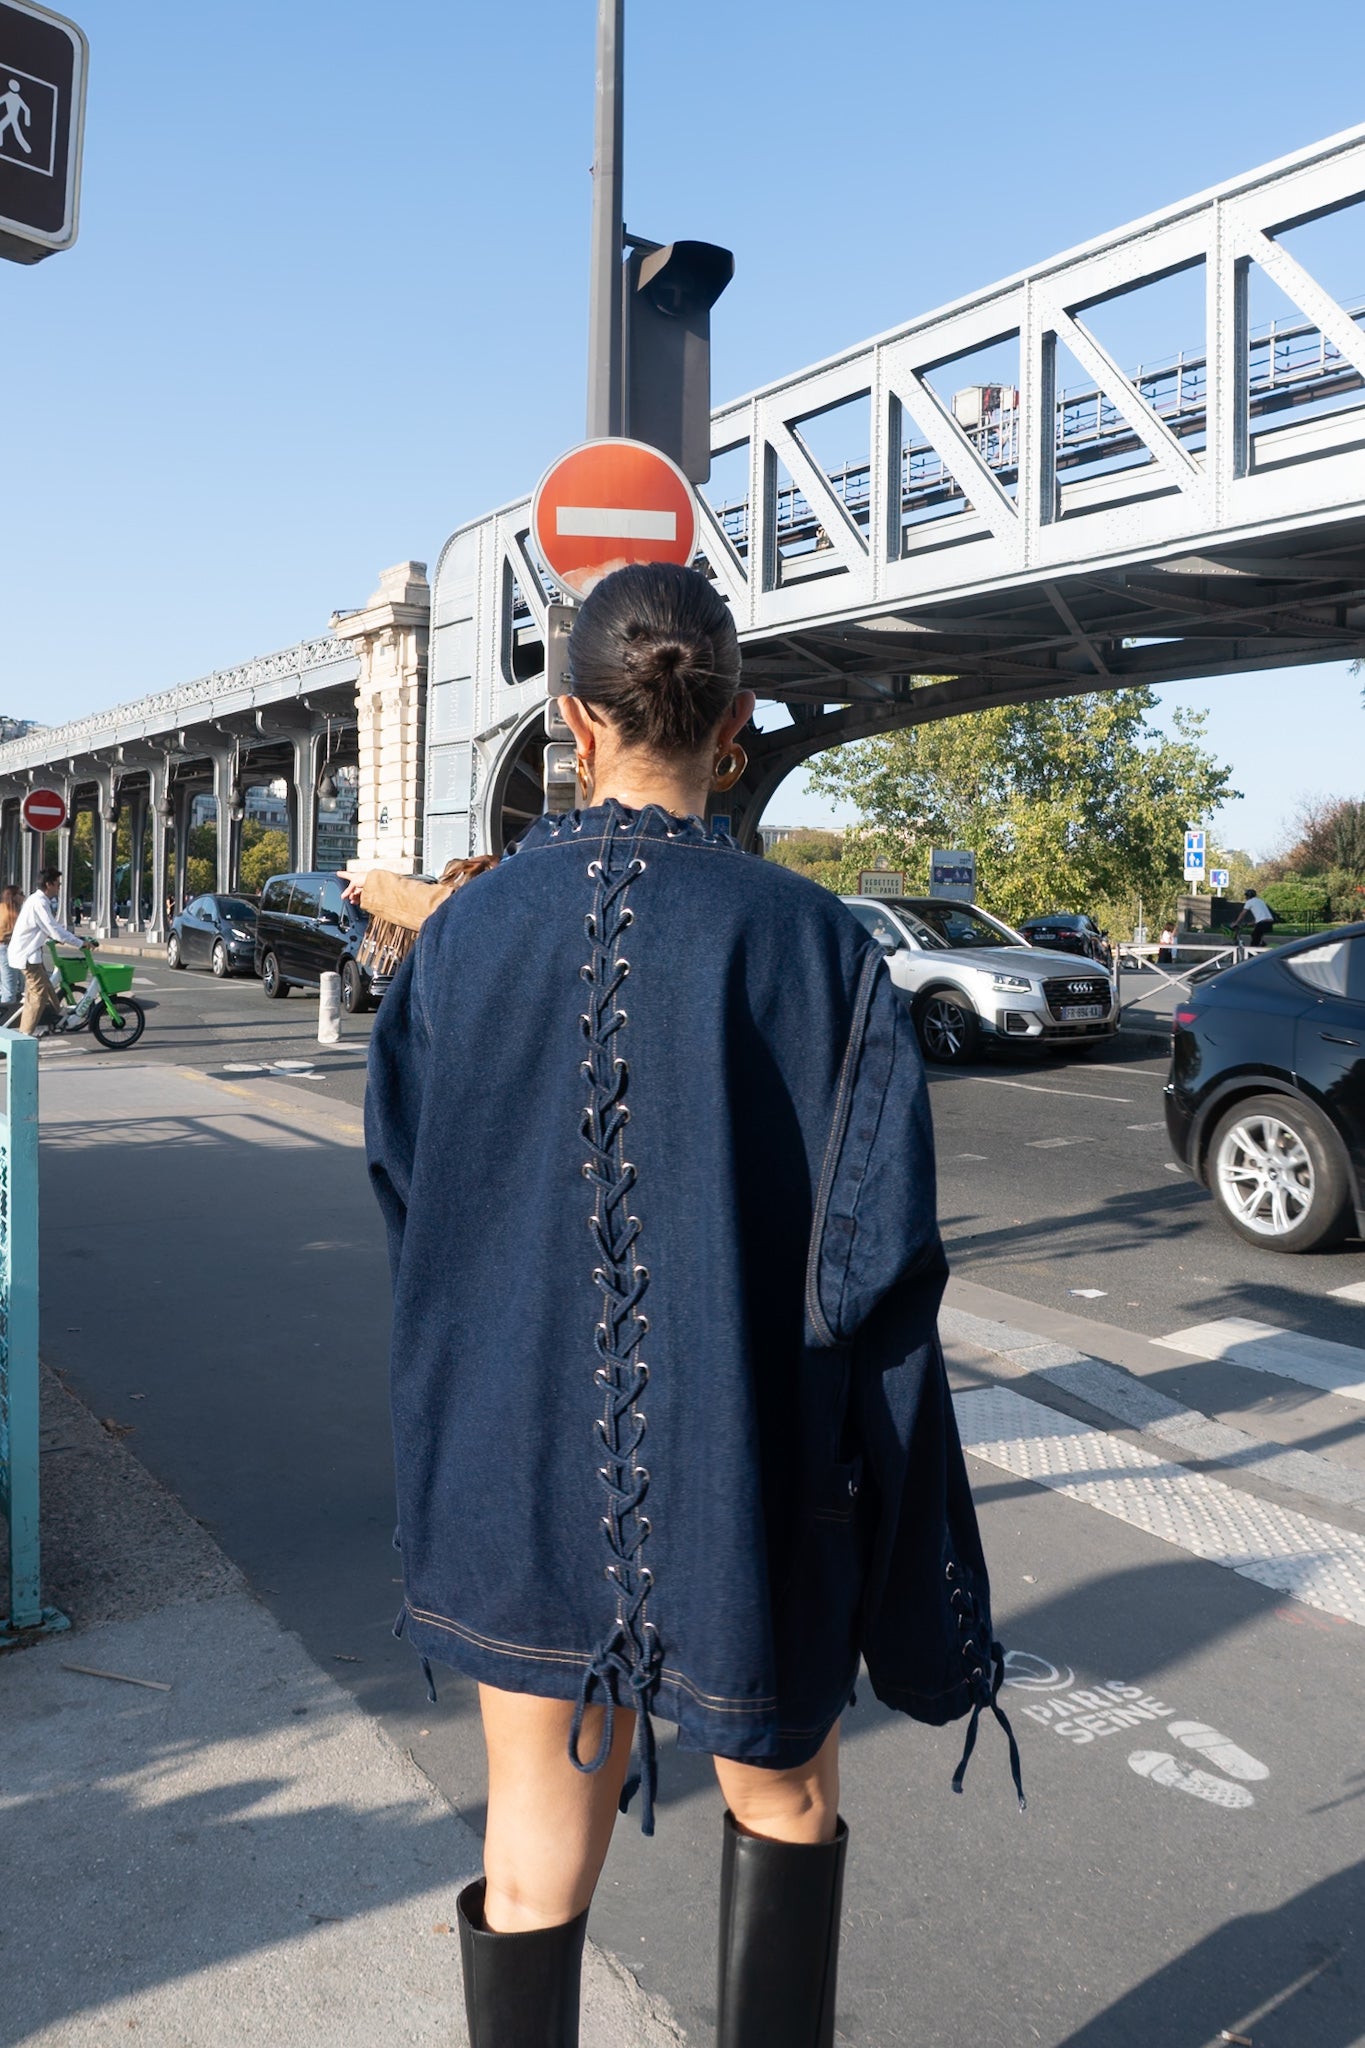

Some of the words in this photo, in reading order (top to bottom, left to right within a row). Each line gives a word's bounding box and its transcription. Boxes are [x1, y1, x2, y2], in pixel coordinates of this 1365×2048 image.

[864, 886, 872, 894] DE
[1020, 1680, 1143, 1726] PARIS
[1054, 1696, 1176, 1743] SEINE
